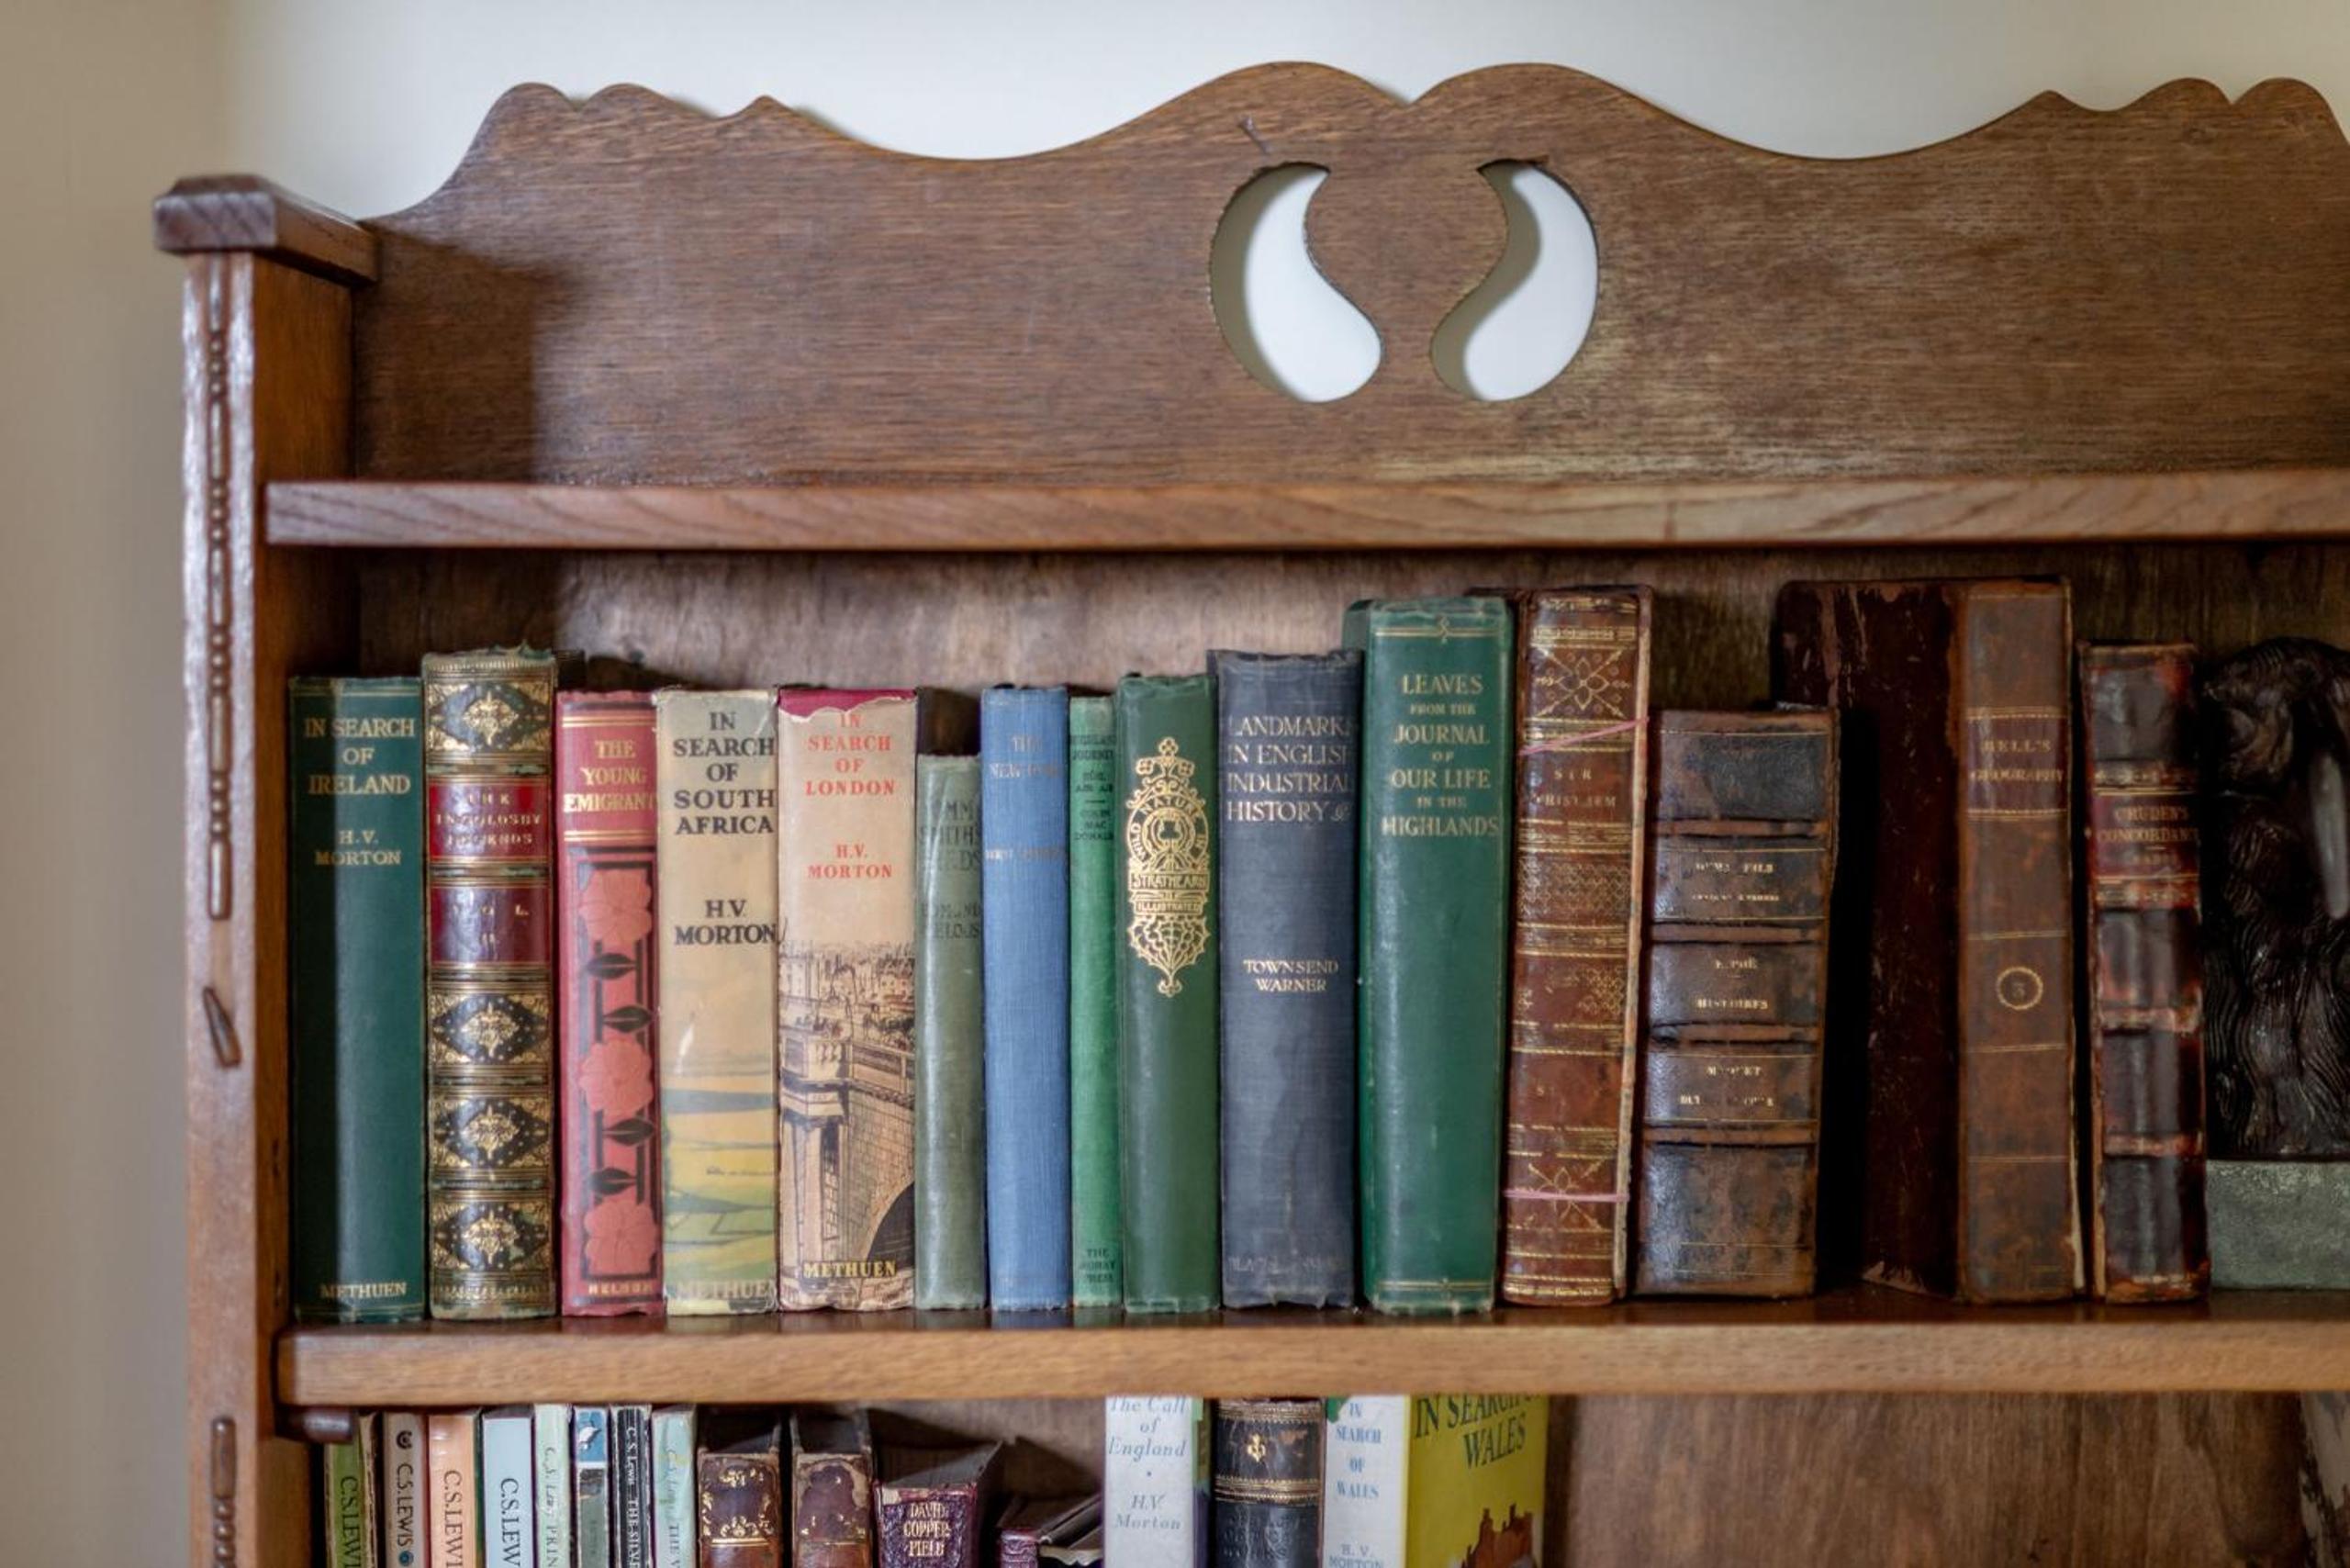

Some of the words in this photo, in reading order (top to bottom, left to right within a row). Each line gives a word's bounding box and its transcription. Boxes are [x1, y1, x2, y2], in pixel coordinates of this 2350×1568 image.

[1402, 674, 1484, 695] LEAVES
[1410, 703, 1446, 716] FROM
[1450, 703, 1477, 716] THE
[304, 719, 325, 737] IN
[332, 719, 416, 738] SEARCH
[709, 711, 734, 731] IN
[839, 712, 861, 728] IN
[1228, 715, 1349, 737] LANDMARK
[1394, 724, 1491, 745] JOURNAL
[594, 739, 636, 759] THE
[673, 738, 775, 757] SEARCH
[807, 736, 892, 752] SEARCH
[342, 747, 375, 766] OF
[1227, 745, 1249, 765] IN
[1431, 751, 1455, 763] OF
[706, 763, 740, 781] OF
[834, 758, 865, 773] OF
[308, 775, 411, 796] IRELAND
[1391, 769, 1438, 790] OUR
[1444, 769, 1492, 790] LIFE
[805, 781, 897, 796] LONDON
[673, 790, 776, 810] SOUTH
[1416, 796, 1432, 809] IN
[1438, 796, 1467, 809] THE
[1226, 801, 1330, 823] HISTORY
[675, 816, 775, 835] AFRICA
[1382, 816, 1500, 836] HIGHLANDS
[339, 830, 379, 845] H.V.
[315, 850, 401, 866] MORTON
[835, 845, 868, 859] H.V.
[808, 865, 893, 879] MORTON
[1132, 874, 1207, 889] STRATHEARN
[674, 924, 779, 946] MORTON
[1244, 960, 1339, 974] TOWNSEND
[1255, 979, 1327, 992] WARNER
[802, 1260, 897, 1277] METHUEN
[319, 1282, 407, 1300] METHUEN
[1110, 1396, 1141, 1412] The
[1147, 1395, 1186, 1414] Call
[1349, 1403, 1362, 1417] IN
[1416, 1394, 1440, 1439] IN
[1140, 1417, 1161, 1434] of
[1336, 1427, 1382, 1444] SEARCH
[1463, 1411, 1526, 1469] WALES
[1108, 1436, 1187, 1462] England
[1349, 1458, 1365, 1473] OF
[1337, 1481, 1379, 1498] WALES
[911, 1501, 946, 1518] DAVID
[1114, 1513, 1181, 1530] Morton
[907, 1540, 945, 1557] FIELD
